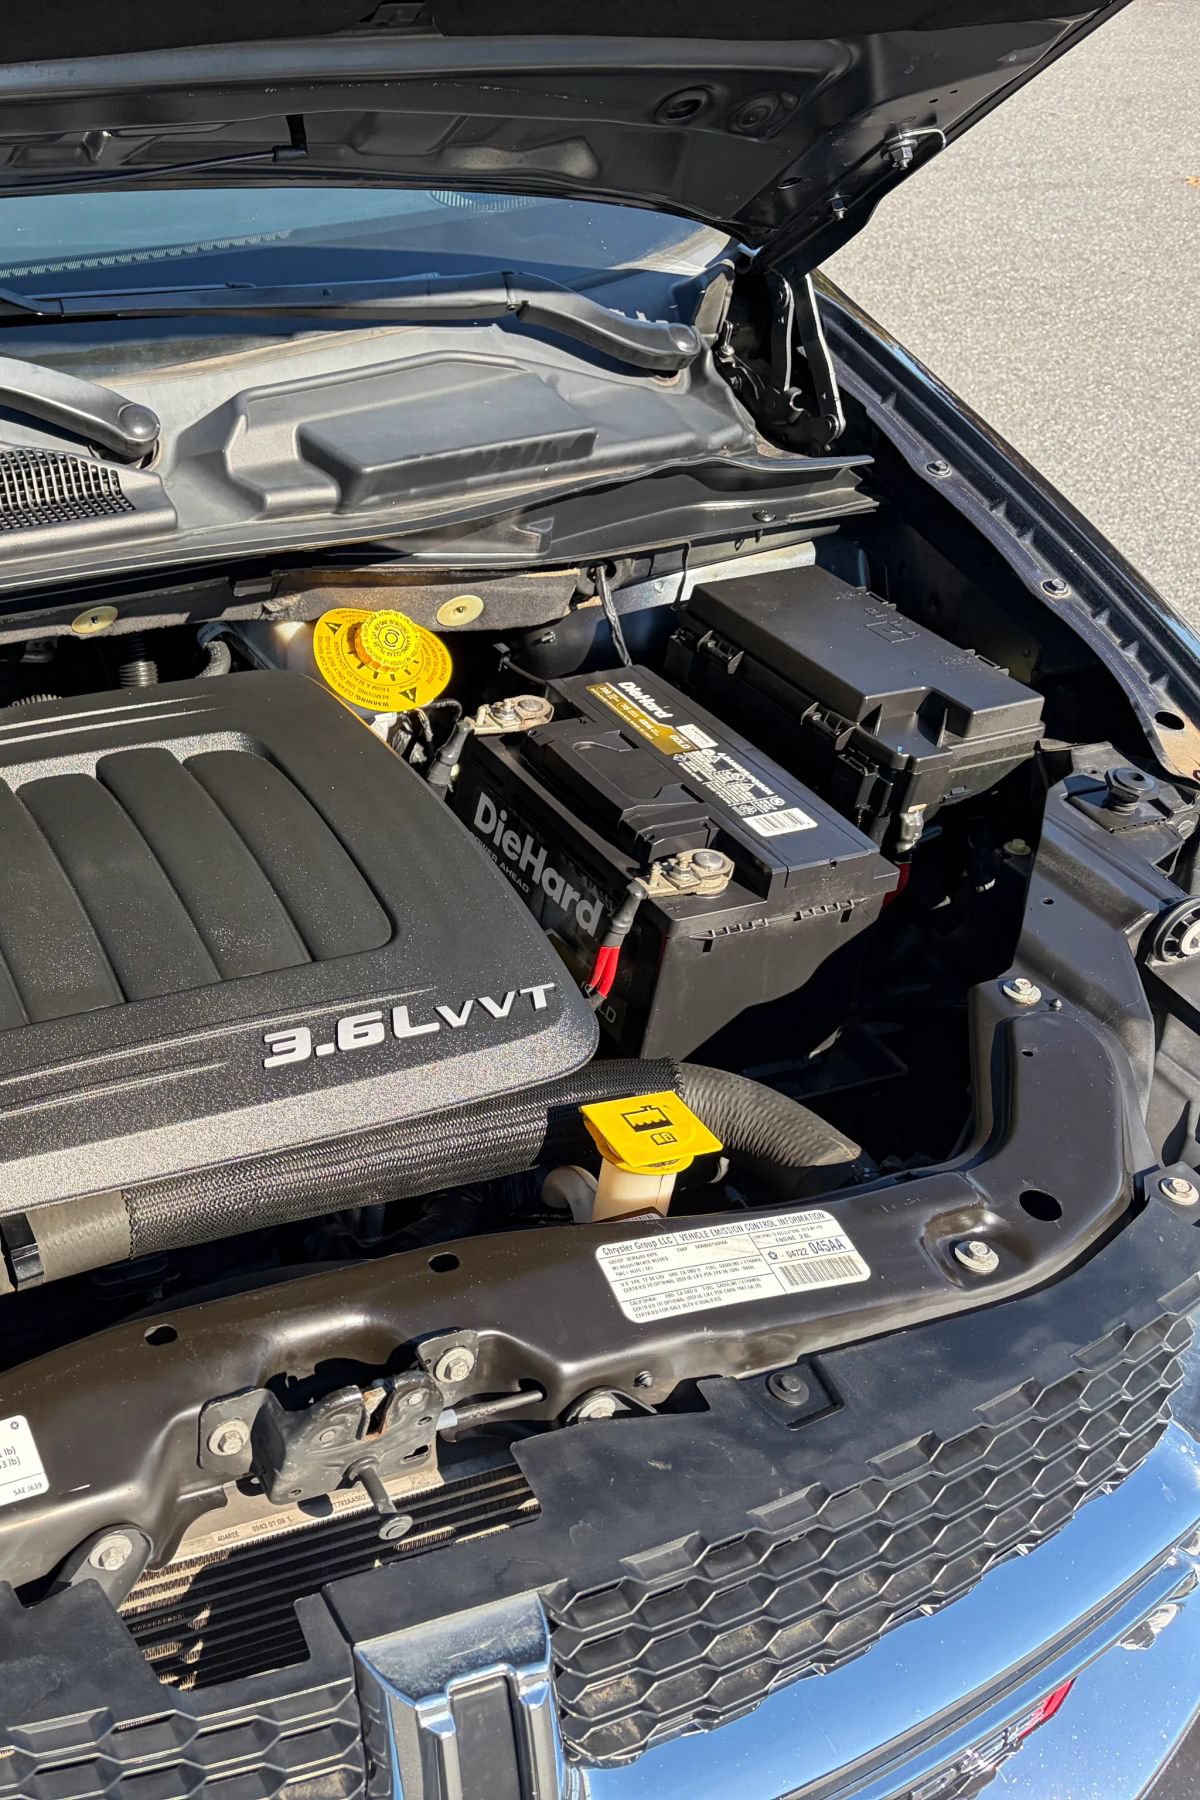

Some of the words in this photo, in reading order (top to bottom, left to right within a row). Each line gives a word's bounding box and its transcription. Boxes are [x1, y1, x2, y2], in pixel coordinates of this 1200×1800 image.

[337, 682, 356, 698] CLEAN
[618, 681, 674, 719] DieHard
[474, 792, 604, 938] DieHard
[500, 862, 530, 893] AHEAD
[602, 1245, 633, 1256] Chrysler
[634, 1240, 658, 1250] Group
[657, 1236, 673, 1246] LLC
[678, 1230, 710, 1242] VEHICLE
[709, 1225, 744, 1237] EMISSION
[744, 1220, 778, 1231] CONTROL
[777, 1212, 825, 1225] INFORMATION
[775, 1235, 796, 1243] ENGINE
[786, 1248, 809, 1258] 04722
[808, 1238, 846, 1254] 045AA
[3, 1446, 16, 1456] lb)
[8, 1456, 21, 1466] lb)
[13, 1487, 26, 1496] SAE
[27, 1482, 42, 1492] J639
